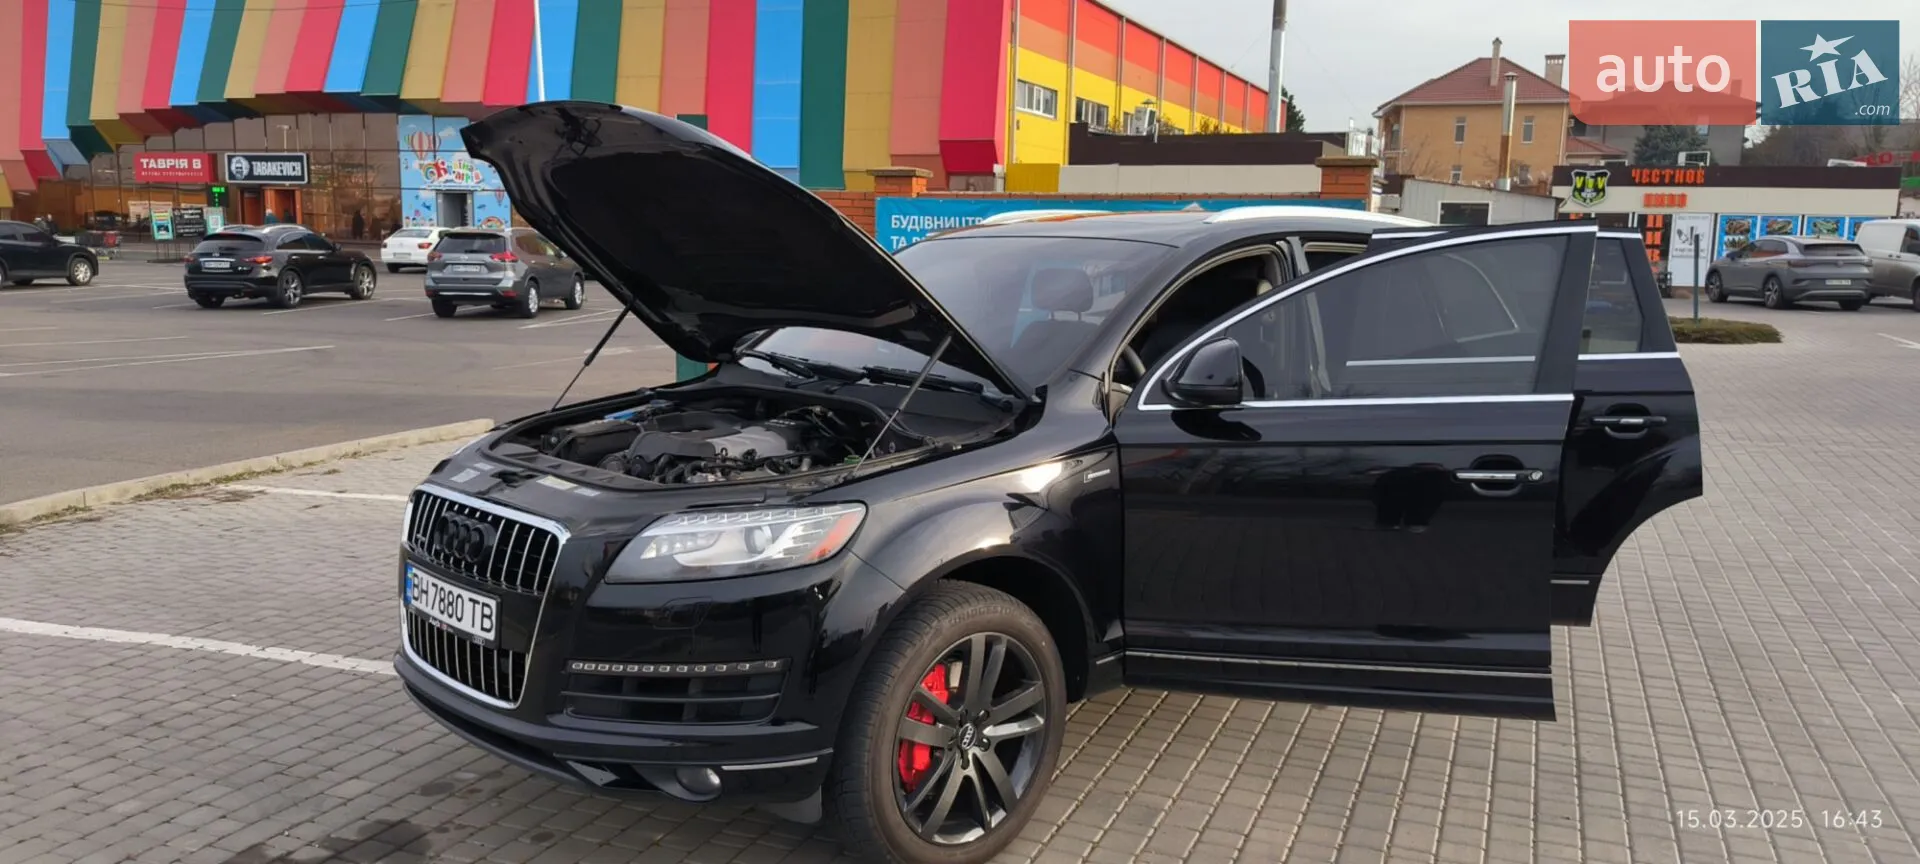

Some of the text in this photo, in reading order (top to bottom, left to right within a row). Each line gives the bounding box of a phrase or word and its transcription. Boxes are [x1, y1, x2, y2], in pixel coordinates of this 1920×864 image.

[140, 158, 202, 169] ТАВРІЯ В
[251, 160, 302, 176] TABAKEVICH
[1631, 168, 1706, 184] ЧЕСТНОЕ
[890, 236, 907, 250] ТА
[430, 582, 464, 621] 7880
[468, 597, 494, 633] TB
